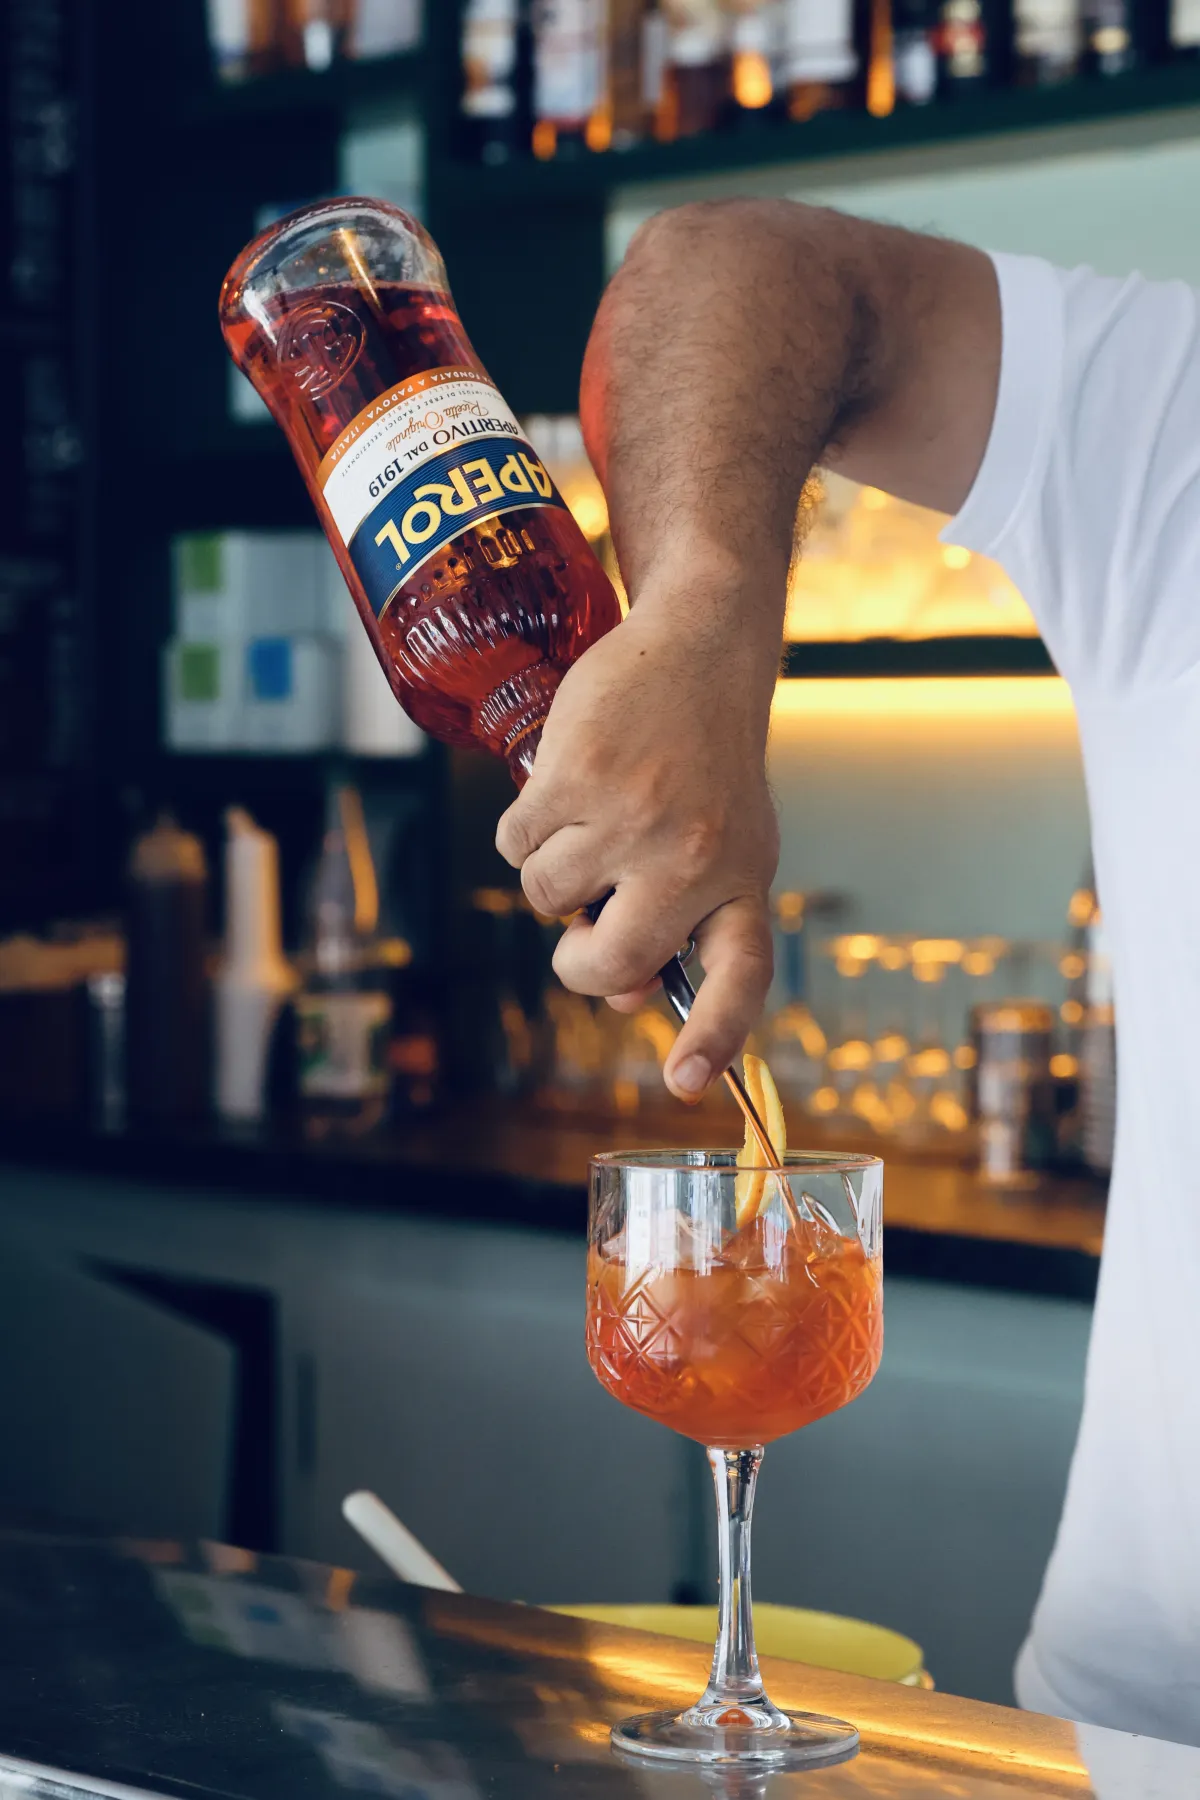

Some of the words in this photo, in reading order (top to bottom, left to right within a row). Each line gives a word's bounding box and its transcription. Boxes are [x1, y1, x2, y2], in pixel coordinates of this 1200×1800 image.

[429, 382, 474, 395] FRATELLI
[430, 371, 481, 382] FONDATA
[366, 384, 414, 419] PADOVA
[424, 396, 444, 406] ERBE
[443, 400, 489, 419] Ricetta
[385, 409, 414, 431] RADICI
[386, 411, 444, 453] Originale
[433, 418, 519, 445] APERITIVO
[330, 425, 360, 461] ITALIA
[341, 431, 382, 477] SELEZIONATE
[404, 441, 429, 461] DAL
[369, 457, 405, 498] 1919
[374, 452, 552, 565] APEROL
